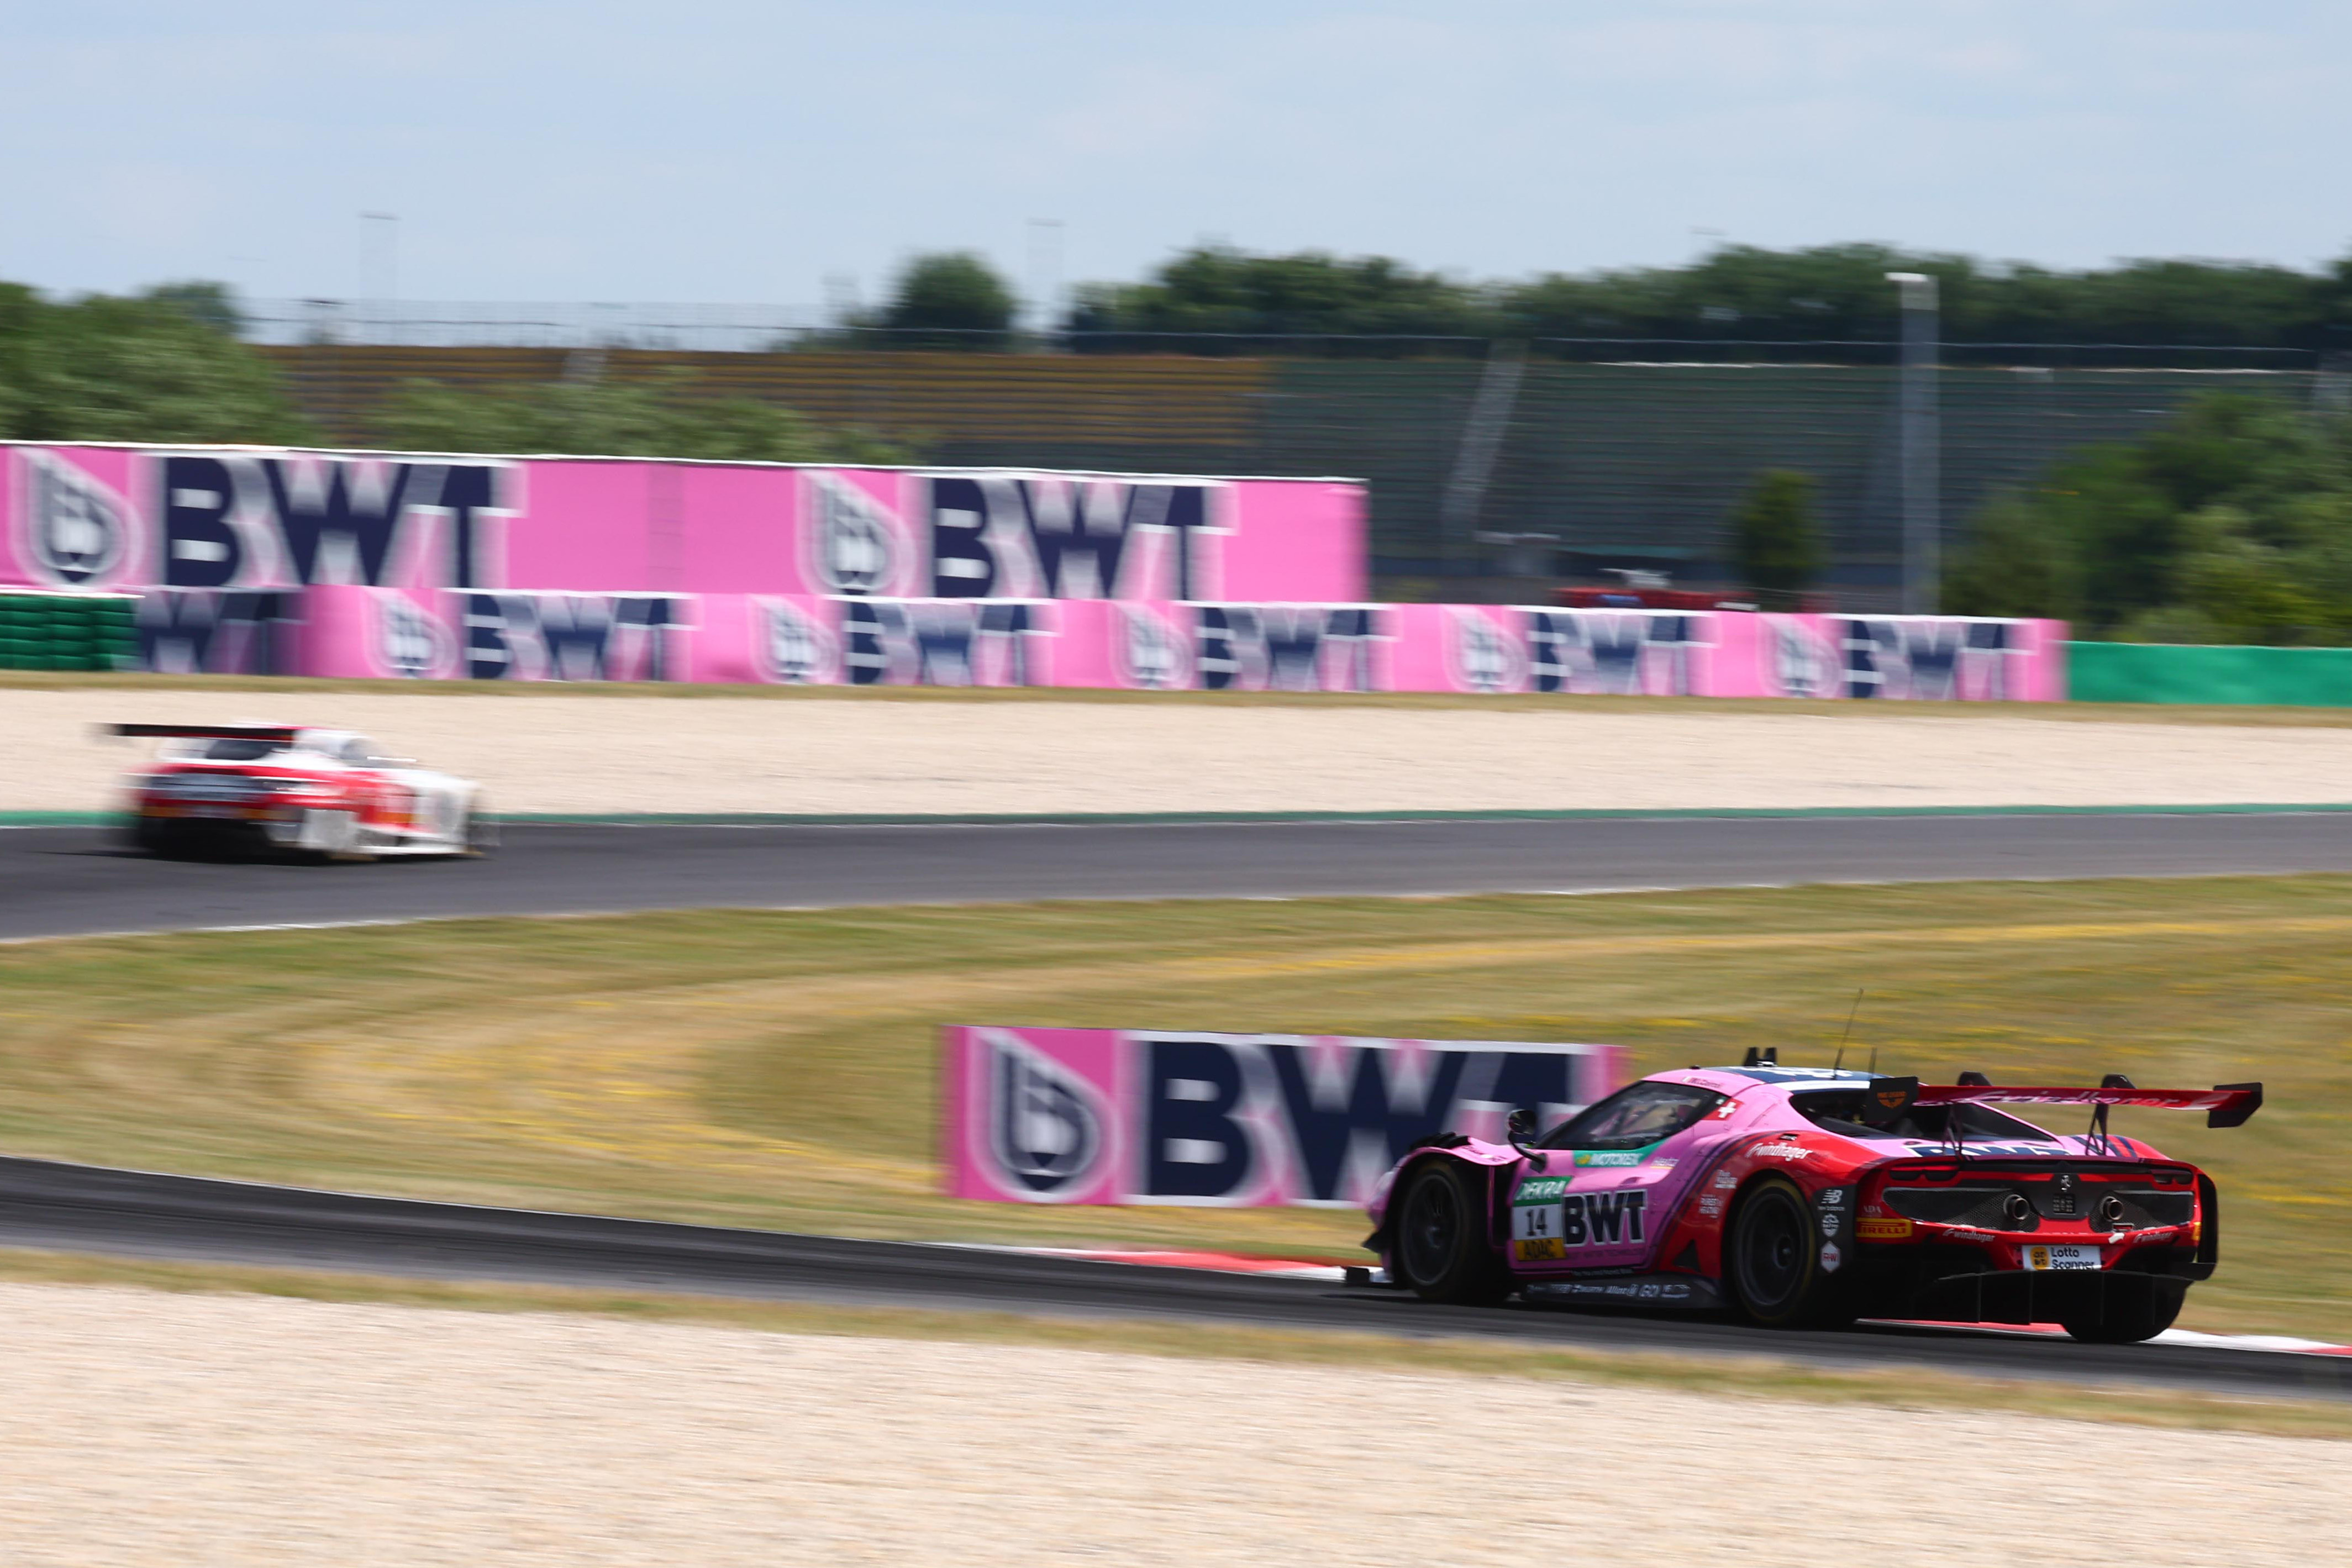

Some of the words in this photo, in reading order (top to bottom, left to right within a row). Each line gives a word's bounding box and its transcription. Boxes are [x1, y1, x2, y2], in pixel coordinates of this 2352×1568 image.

[149, 450, 521, 590] BWT
[917, 473, 1236, 601] BWT
[134, 591, 309, 672] WT
[464, 589, 699, 682] BWT
[843, 594, 1060, 687] BWT
[1196, 601, 1399, 693] BWT
[1529, 608, 1718, 696] BWT
[1840, 614, 2038, 702] BWT
[1753, 1141, 1813, 1161] windhager
[1527, 1208, 1546, 1236] 14
[1562, 1188, 1648, 1248] BWT
[1953, 1230, 1996, 1243] windhager
[2051, 1247, 2080, 1257] Lotto
[2051, 1259, 2095, 1270] Scanner
